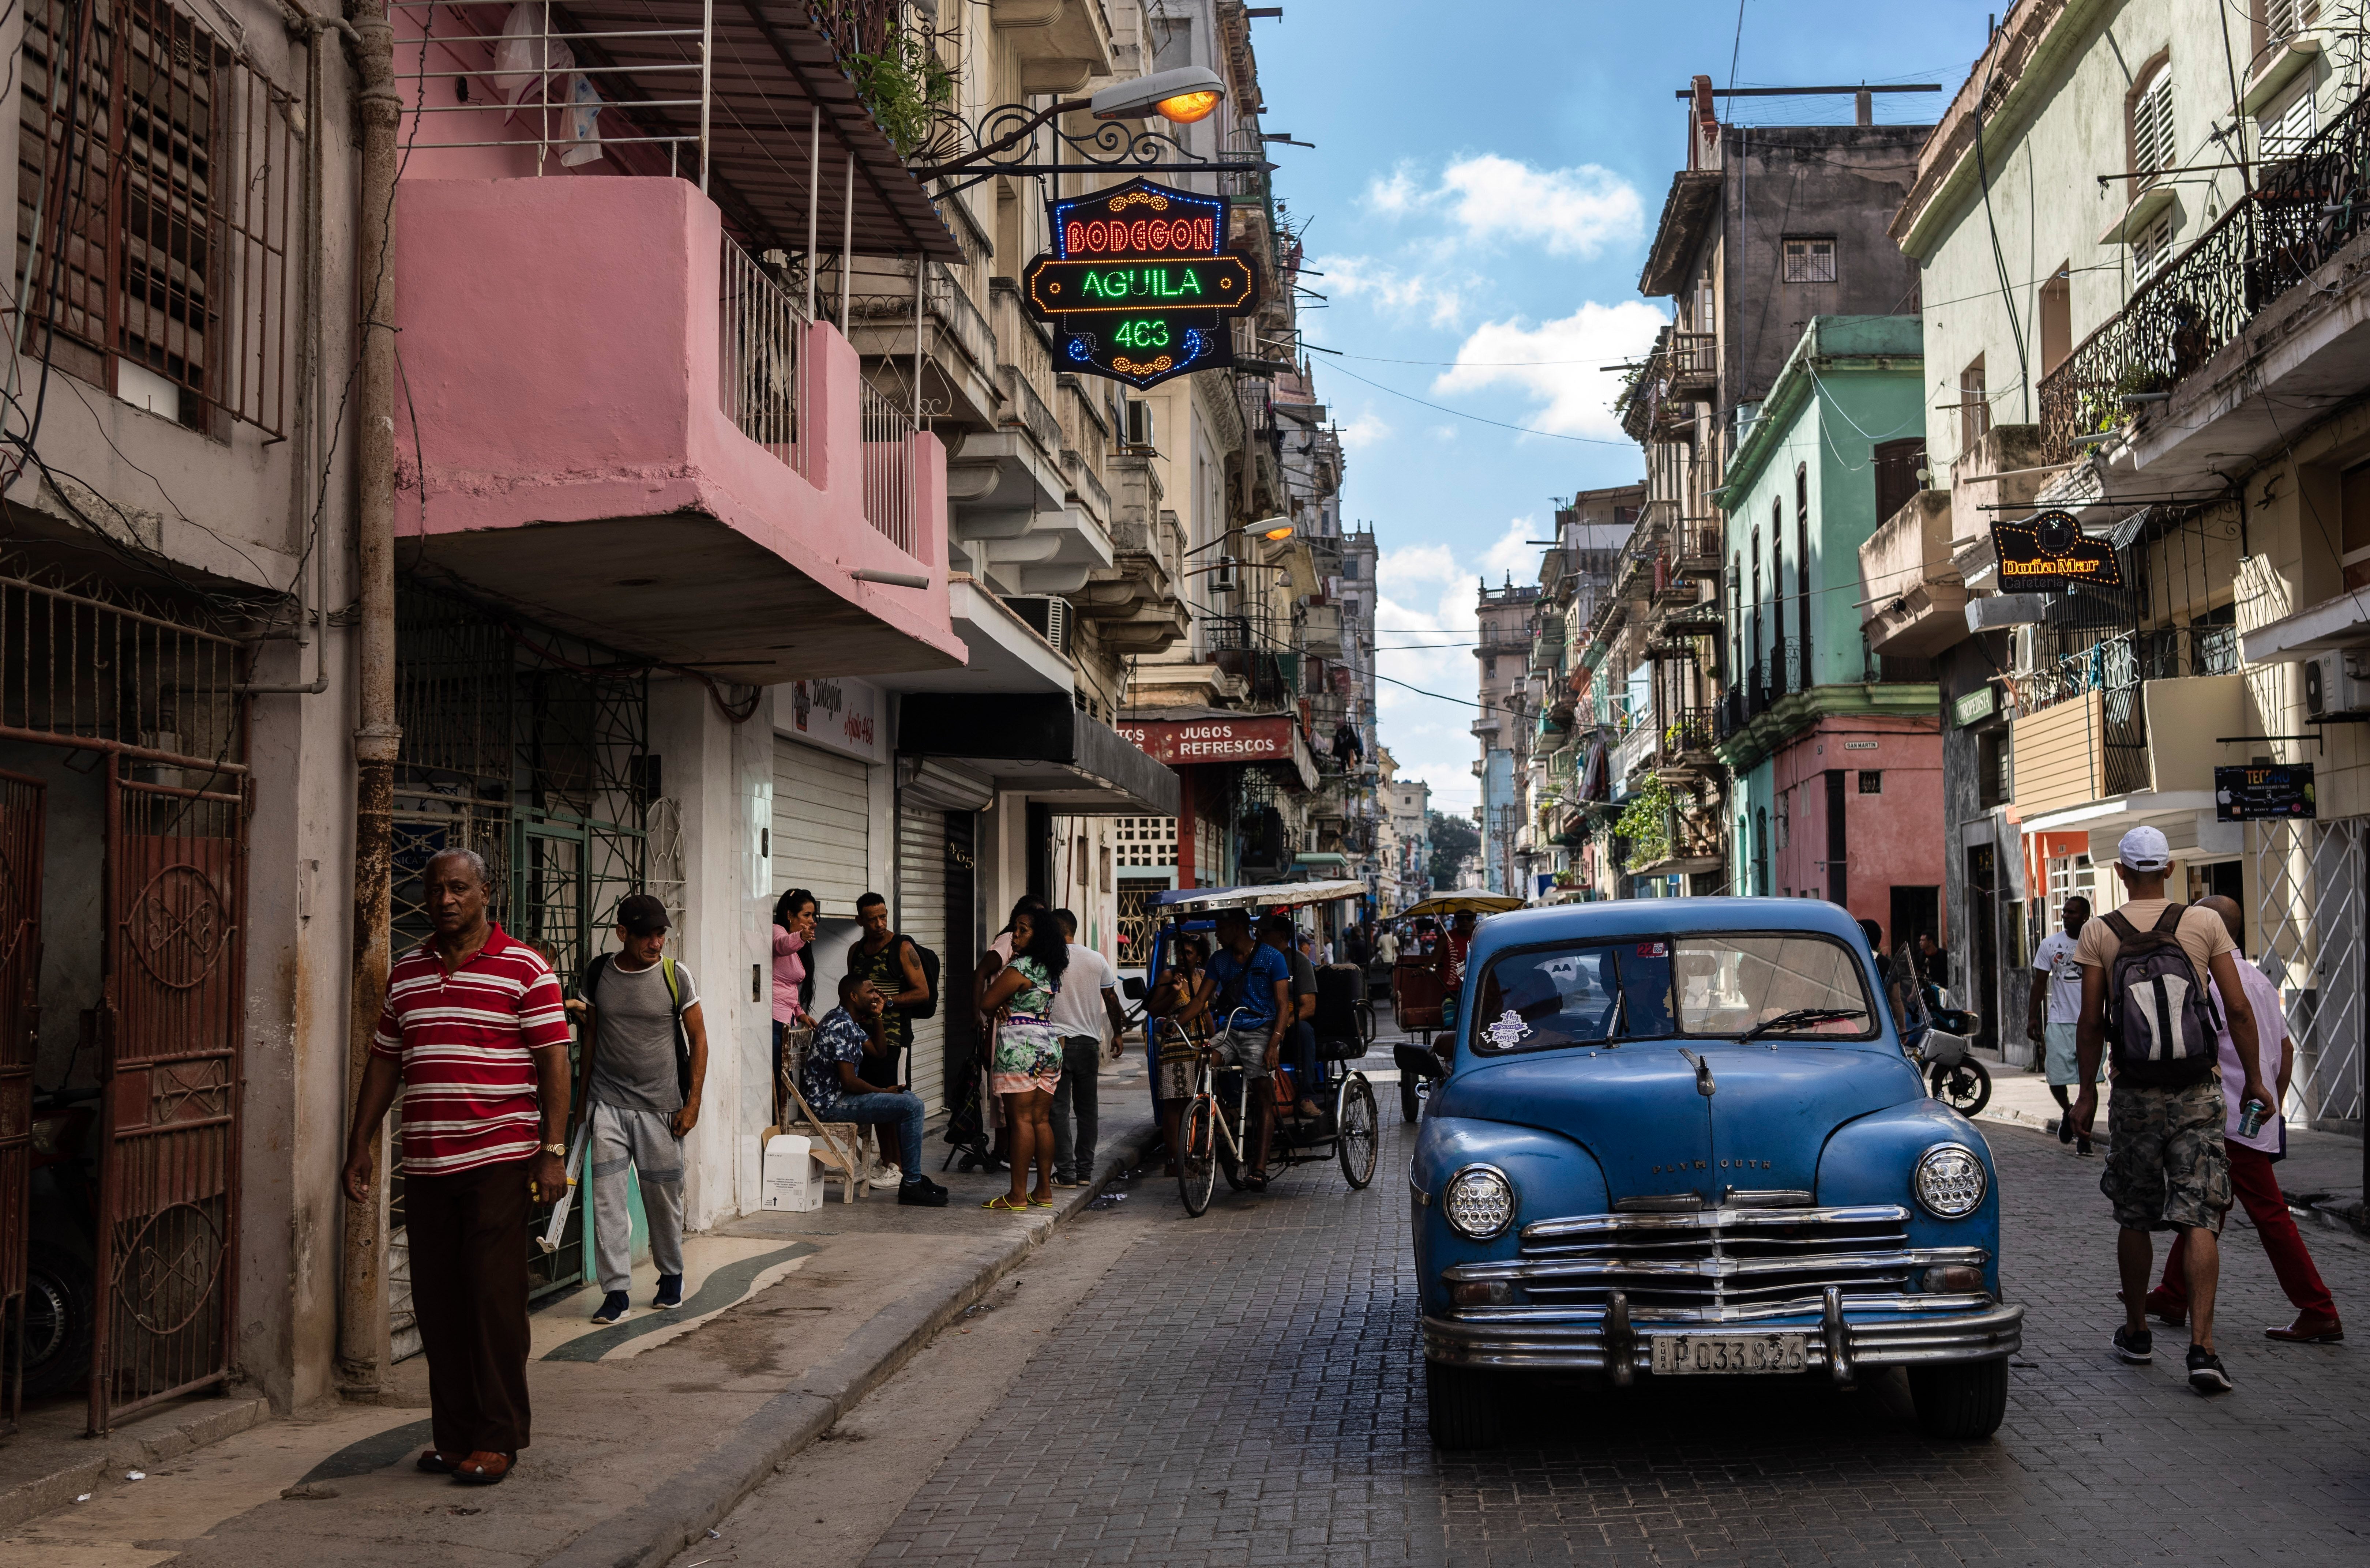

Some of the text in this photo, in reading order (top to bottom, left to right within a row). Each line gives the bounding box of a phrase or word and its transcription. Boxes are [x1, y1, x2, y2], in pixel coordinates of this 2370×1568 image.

[1067, 218, 1213, 253] BODEGON
[1082, 269, 1201, 297] AGUILA
[1115, 321, 1169, 347] 463
[2003, 558, 2112, 575] Doña Mary
[813, 678, 841, 721] Bodegón
[1956, 691, 1990, 725] QUIROPEDISTA
[861, 717, 873, 745] 463
[1180, 726, 1232, 739] JUGOS
[1180, 739, 1275, 755] REFRESCOS
[949, 842, 973, 869] 465
[1638, 944, 1653, 955] 22
[1551, 963, 1572, 973] AA
[1502, 1012, 1519, 1022] Hoy
[1652, 1159, 1771, 1174] PLYMOUTH
[1673, 1342, 1689, 1371] P
